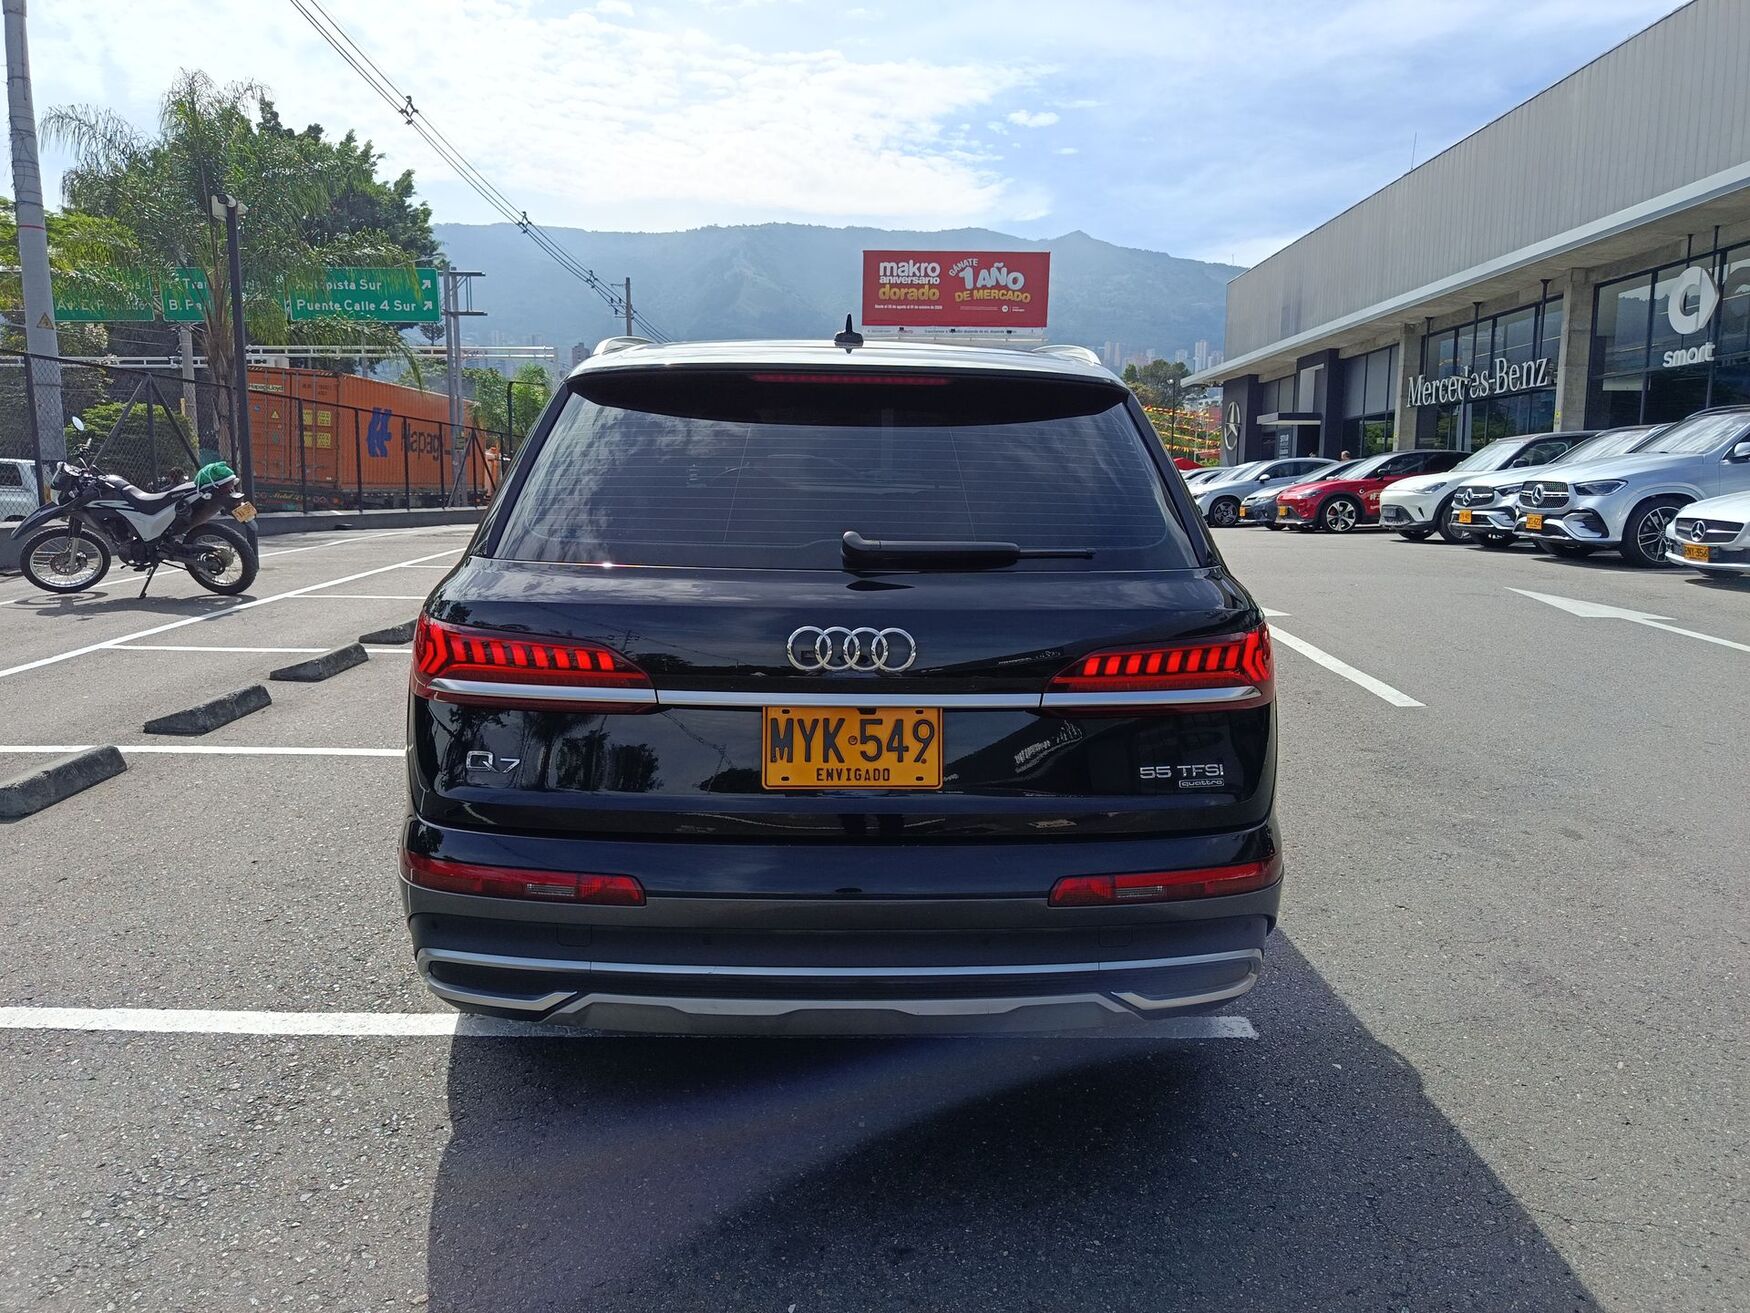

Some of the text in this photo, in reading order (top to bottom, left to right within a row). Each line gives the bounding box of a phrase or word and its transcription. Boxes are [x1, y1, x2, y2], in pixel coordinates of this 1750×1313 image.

[879, 259, 941, 277] makro
[879, 275, 941, 285] aniversario
[959, 262, 1025, 290] 1 AÑO
[359, 279, 382, 291] Sur
[879, 284, 940, 301] dorado
[955, 289, 1032, 304] DE MERCADO
[297, 300, 416, 311] Puente Calle 4 Sur
[1406, 357, 1548, 408] Mercedes-Benz
[769, 717, 936, 763] MYK 549
[466, 750, 520, 773] Q7
[816, 767, 891, 782] ENVIGADO
[1139, 765, 1172, 779] 55
[1180, 779, 1223, 787] quattro
